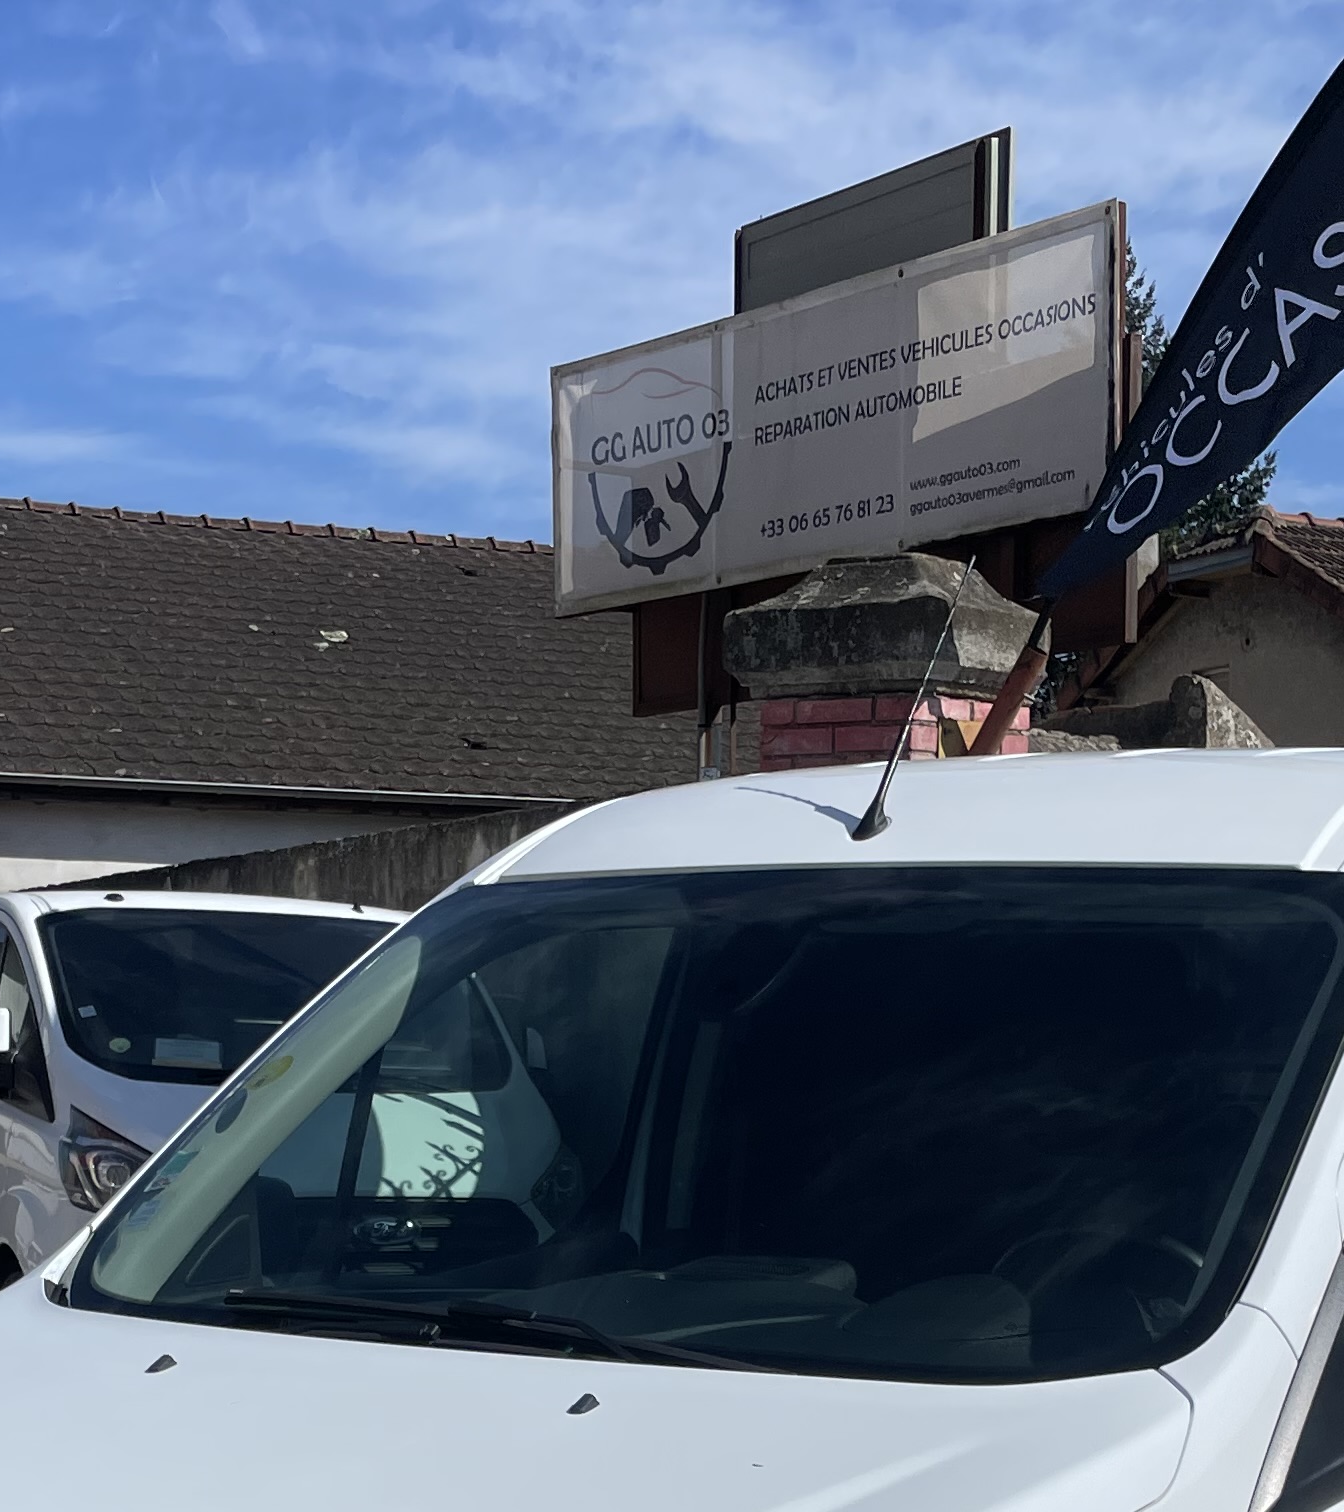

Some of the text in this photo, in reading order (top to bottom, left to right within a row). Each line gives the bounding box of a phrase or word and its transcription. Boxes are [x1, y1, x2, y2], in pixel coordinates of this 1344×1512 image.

[754, 293, 1097, 406] ACHATS ET VENTES VEHICULES OCCASIONS
[591, 409, 730, 465] GG AUTO 03
[754, 375, 963, 447] REPARATION AUTOMOBILE
[909, 458, 1021, 491] www.ggauto03.com
[760, 493, 895, 539] +33 06 65 76 81 23
